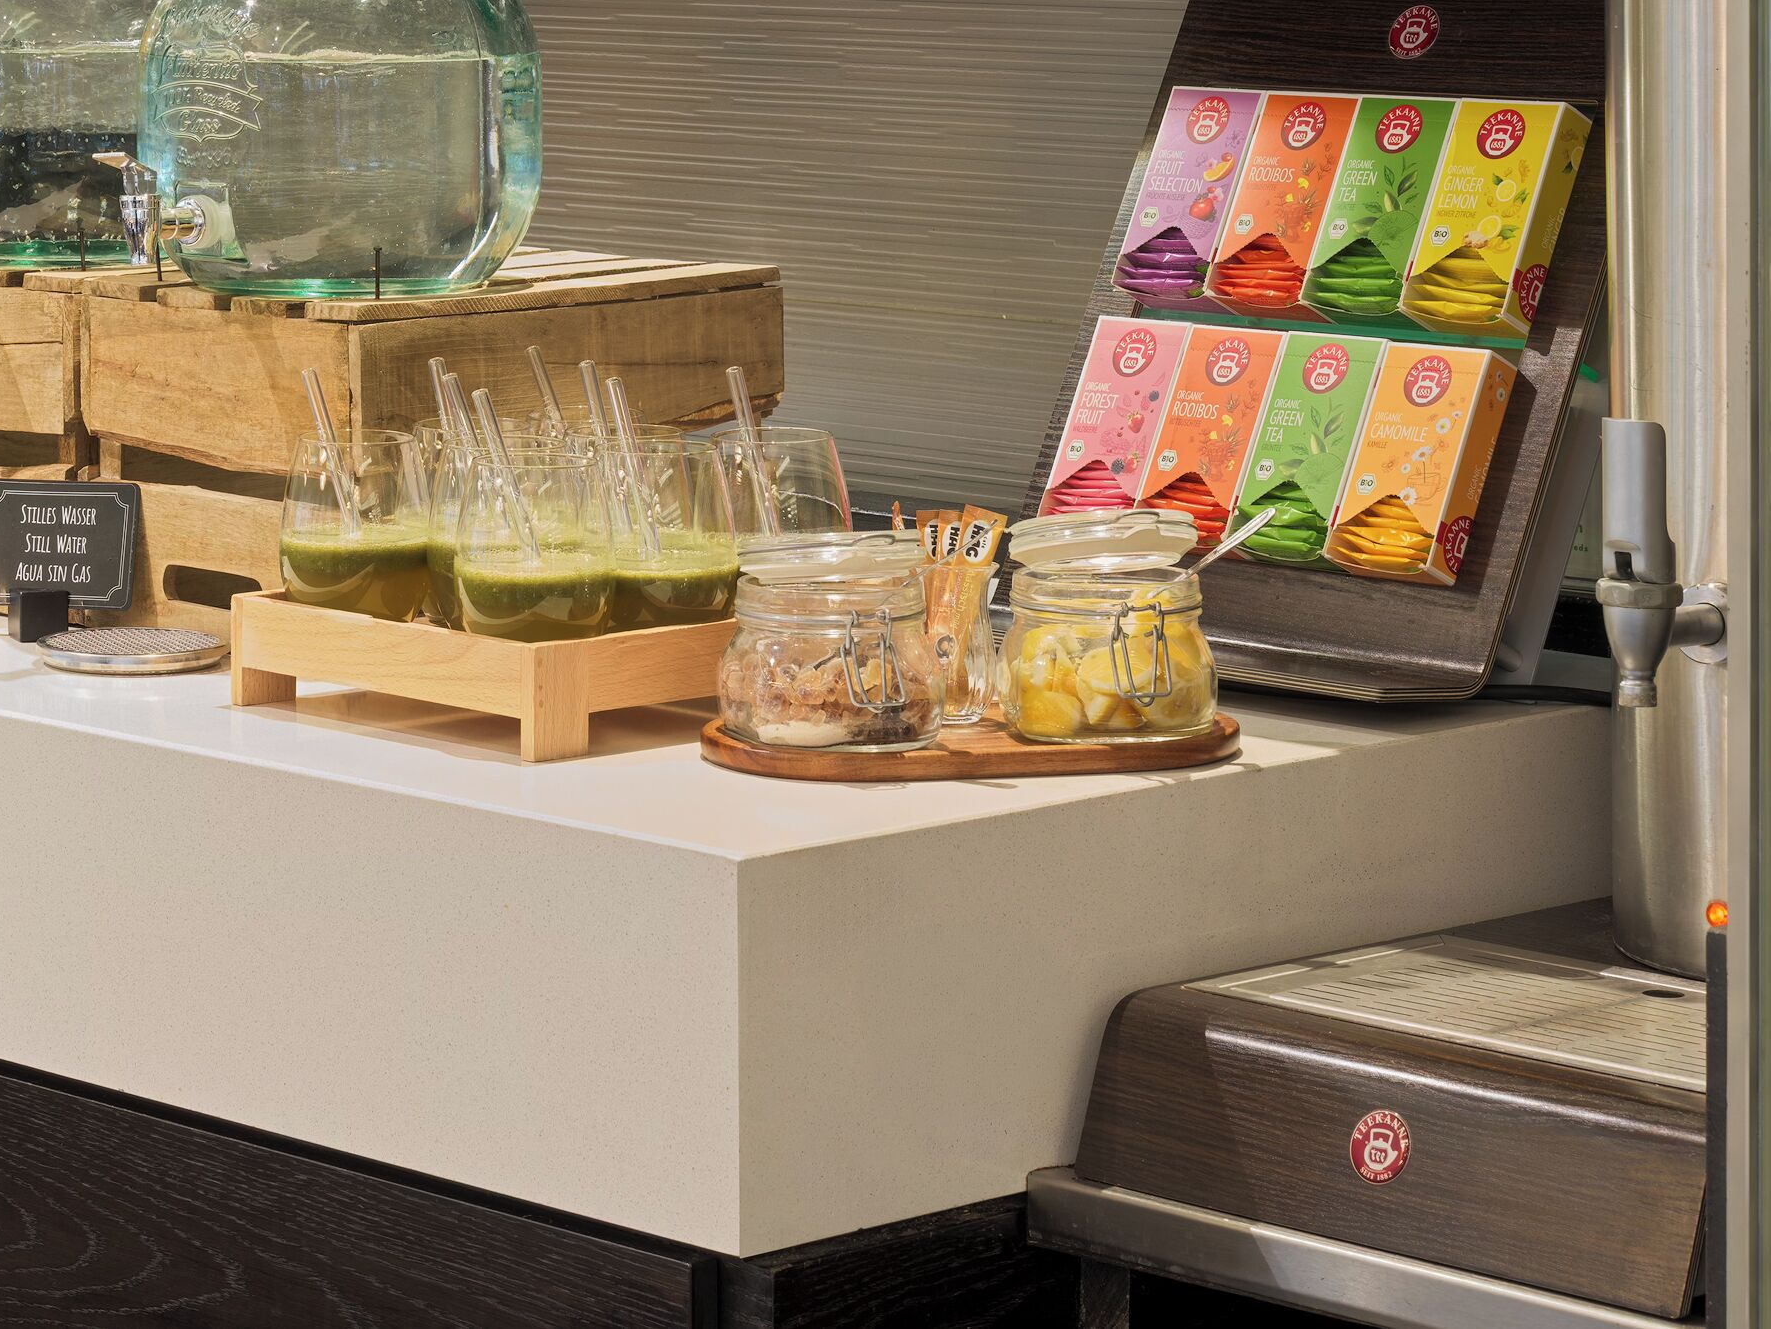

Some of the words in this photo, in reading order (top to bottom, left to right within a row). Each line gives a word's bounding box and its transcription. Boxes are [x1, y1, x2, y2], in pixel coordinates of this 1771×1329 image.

[1393, 7, 1438, 30] TEEKANNE
[1189, 99, 1227, 124] TEEKANNE
[1284, 104, 1325, 129] TEEKANNE
[1378, 107, 1420, 132] TEEKANNE
[1479, 112, 1523, 137] TEEKANNE
[1157, 150, 1185, 160] ORGANIC
[1253, 156, 1281, 166] ORGANIC
[1153, 161, 1185, 175] FRUIT
[1347, 159, 1376, 169] ORGANIC
[1448, 165, 1476, 175] ORGANIC
[1249, 167, 1295, 183] ROOIBOS
[1343, 171, 1378, 186] GREEN
[1444, 175, 1484, 192] GINGER
[1148, 175, 1203, 193] SELECTION
[1338, 187, 1357, 202] TEA
[1438, 193, 1478, 209] LEMON
[1520, 267, 1545, 320] TEEKANNE
[1116, 331, 1156, 356] TEEKANNE
[1208, 339, 1250, 365] TEEKANNE
[1305, 346, 1348, 372] TEEKANNE
[1406, 358, 1449, 385] TEEKANNE
[1085, 381, 1112, 392] ORGANIC
[1080, 392, 1119, 409] FOREST
[1176, 390, 1204, 401] ORGANIC
[1274, 398, 1302, 409] ORGANIC
[1075, 409, 1105, 425] FRUIT
[1172, 401, 1220, 419] ROOIBOS
[1270, 409, 1305, 426] GREEN
[1374, 411, 1403, 422] ORGANIC
[1265, 427, 1284, 442] TEA
[1370, 423, 1428, 442] CAMOMILE
[20, 504, 57, 525] STILLES
[61, 505, 96, 526] WASSER
[25, 533, 51, 553] STILL
[56, 534, 87, 554] WATER
[965, 523, 986, 559] HAG
[1445, 518, 1470, 573] TEEKANNE
[15, 562, 43, 582] AGUA
[47, 565, 67, 582] SIN
[71, 563, 91, 583] GAS
[1353, 1113, 1409, 1148] TEEKANNE
[1359, 1166, 1375, 1180] SEIT
[1376, 1170, 1392, 1181] 1882
